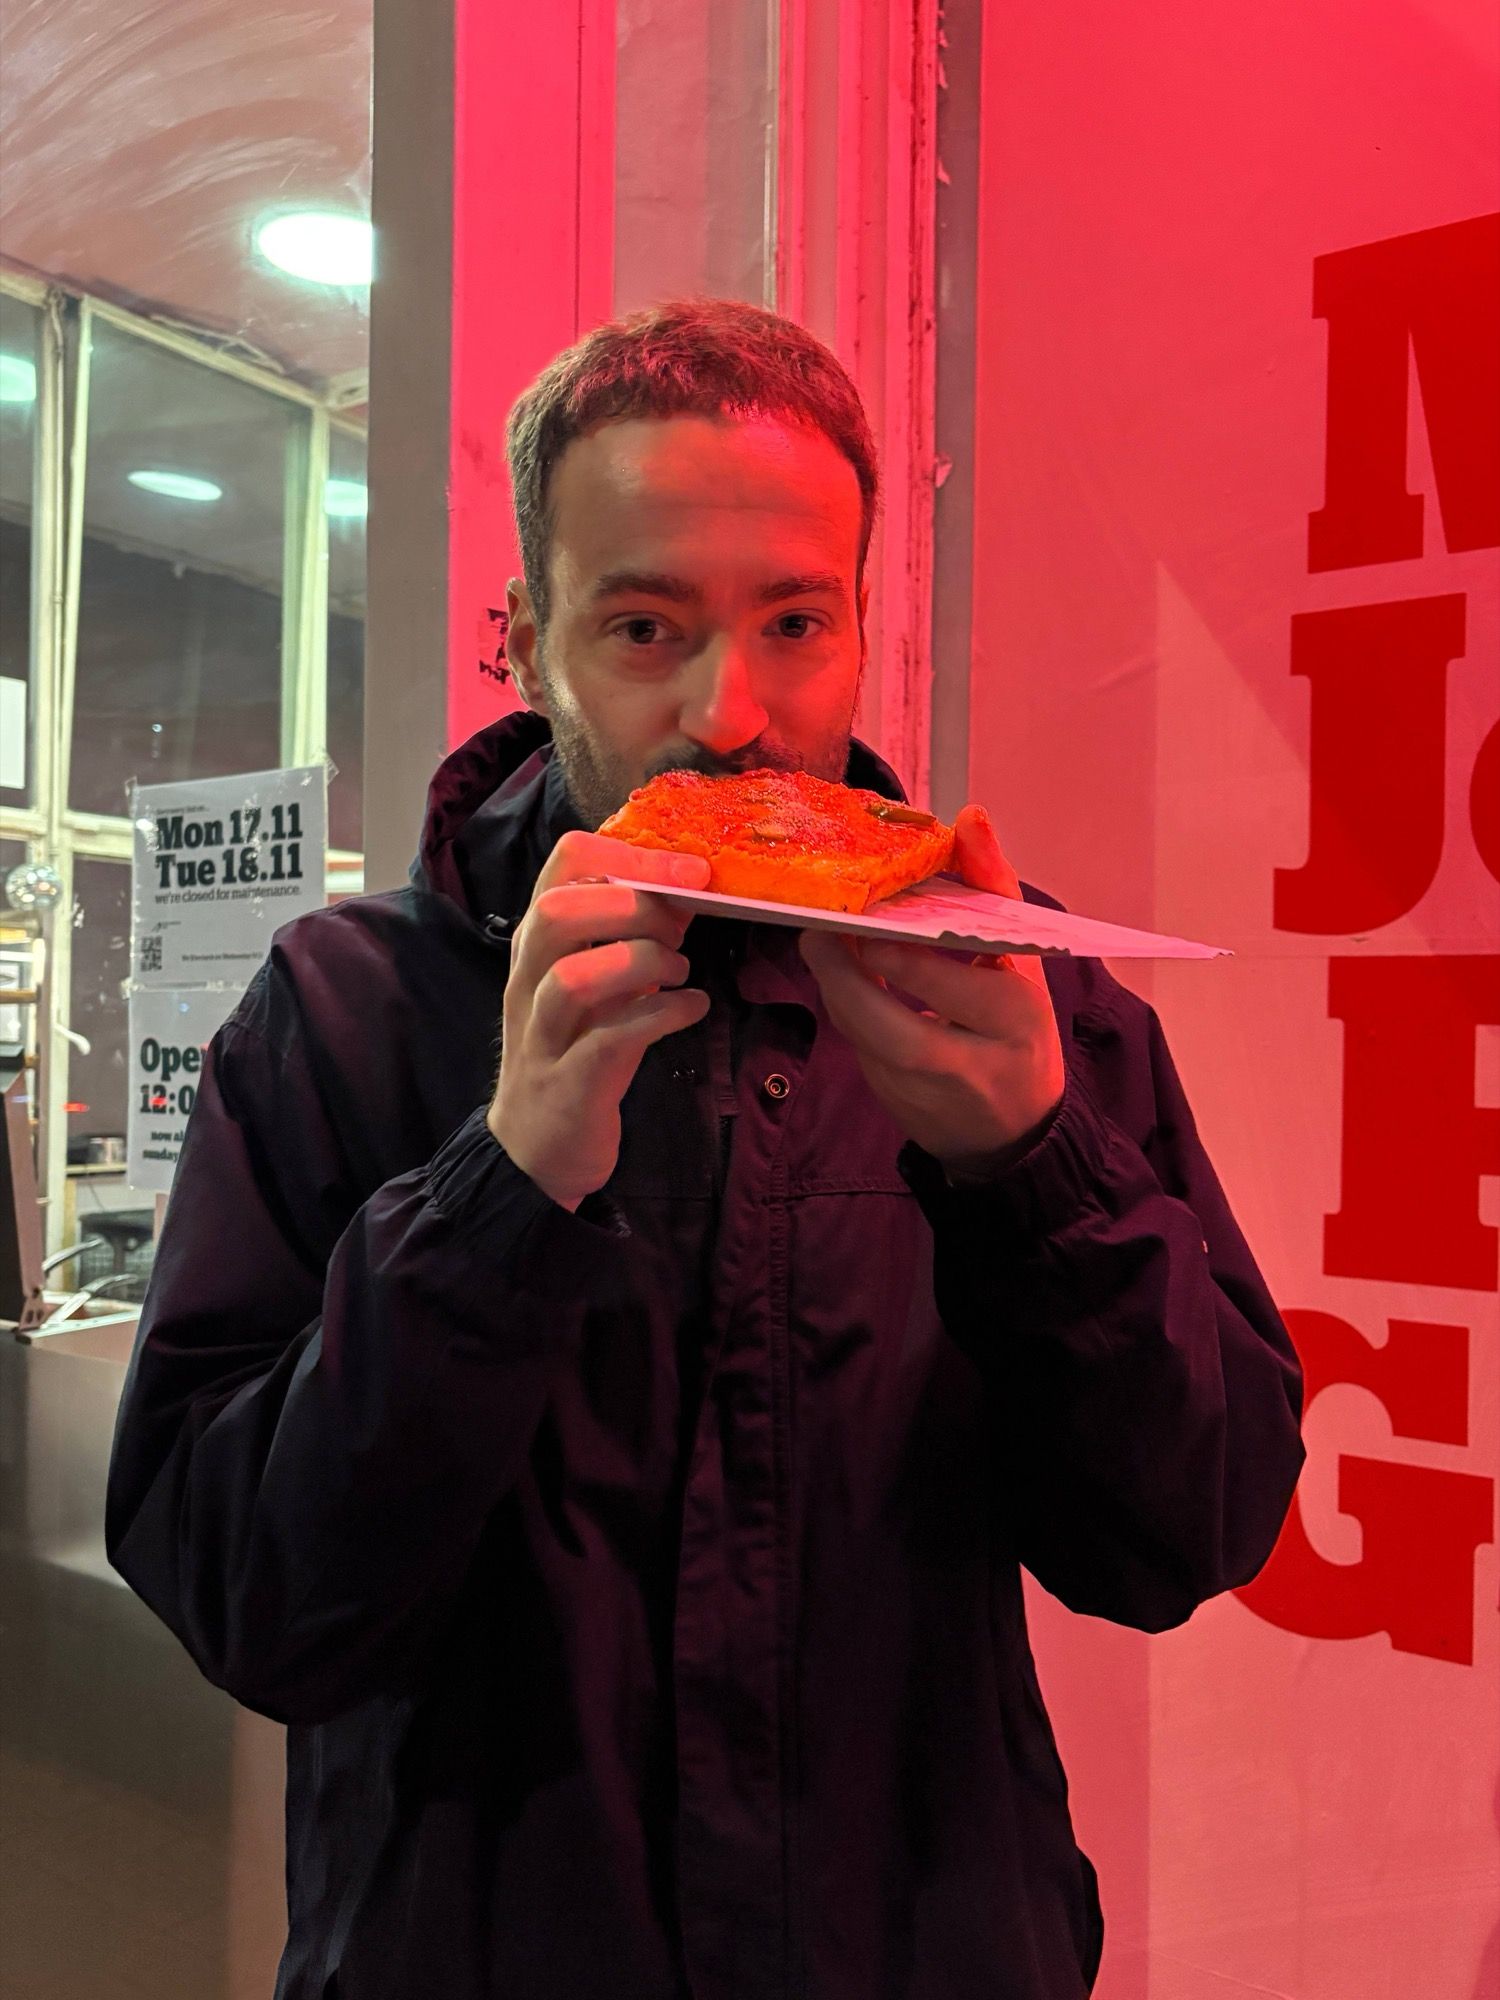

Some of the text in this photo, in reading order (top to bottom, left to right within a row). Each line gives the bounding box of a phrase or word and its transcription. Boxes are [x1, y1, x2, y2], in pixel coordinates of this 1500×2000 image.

[1273, 591, 1500, 936] J
[155, 802, 303, 851] Mon 17.11
[155, 843, 303, 889] Tue 18.11
[182, 888, 215, 904] closed
[216, 888, 230, 901] for
[151, 1131, 172, 1142] now
